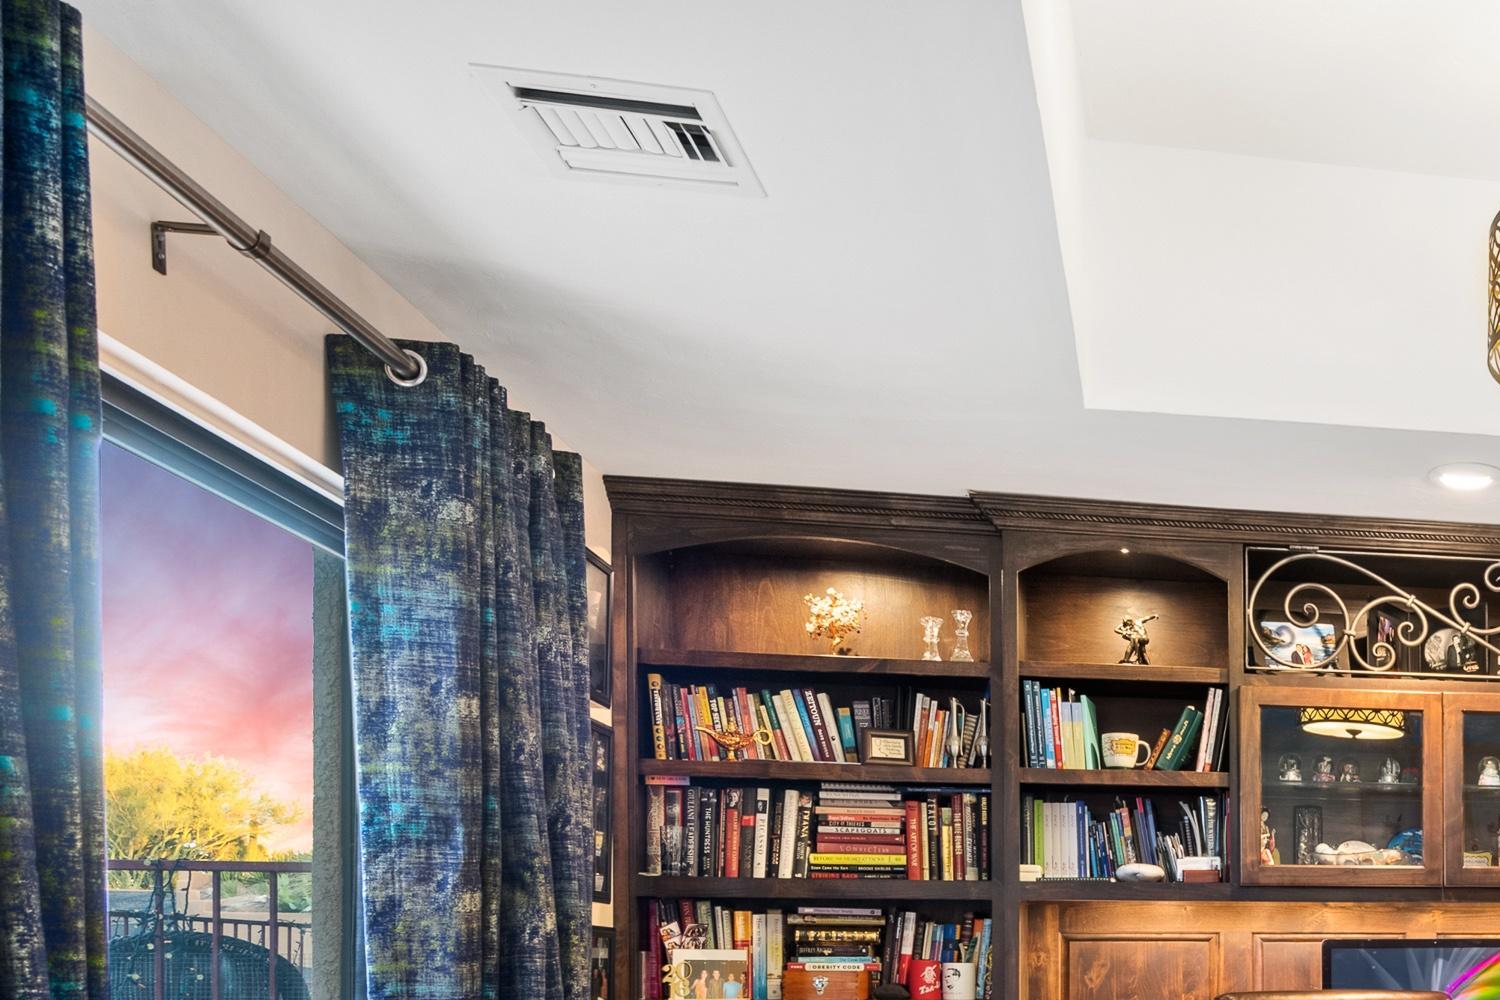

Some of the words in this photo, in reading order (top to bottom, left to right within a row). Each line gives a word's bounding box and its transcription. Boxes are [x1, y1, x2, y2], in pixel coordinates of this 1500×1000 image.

[710, 699, 718, 712] TOP
[714, 713, 722, 732] SECR
[805, 690, 821, 726] ZEITOUN
[687, 789, 695, 820] GIULIANI
[928, 798, 936, 831] ZEALOT
[800, 810, 810, 838] DIANA
